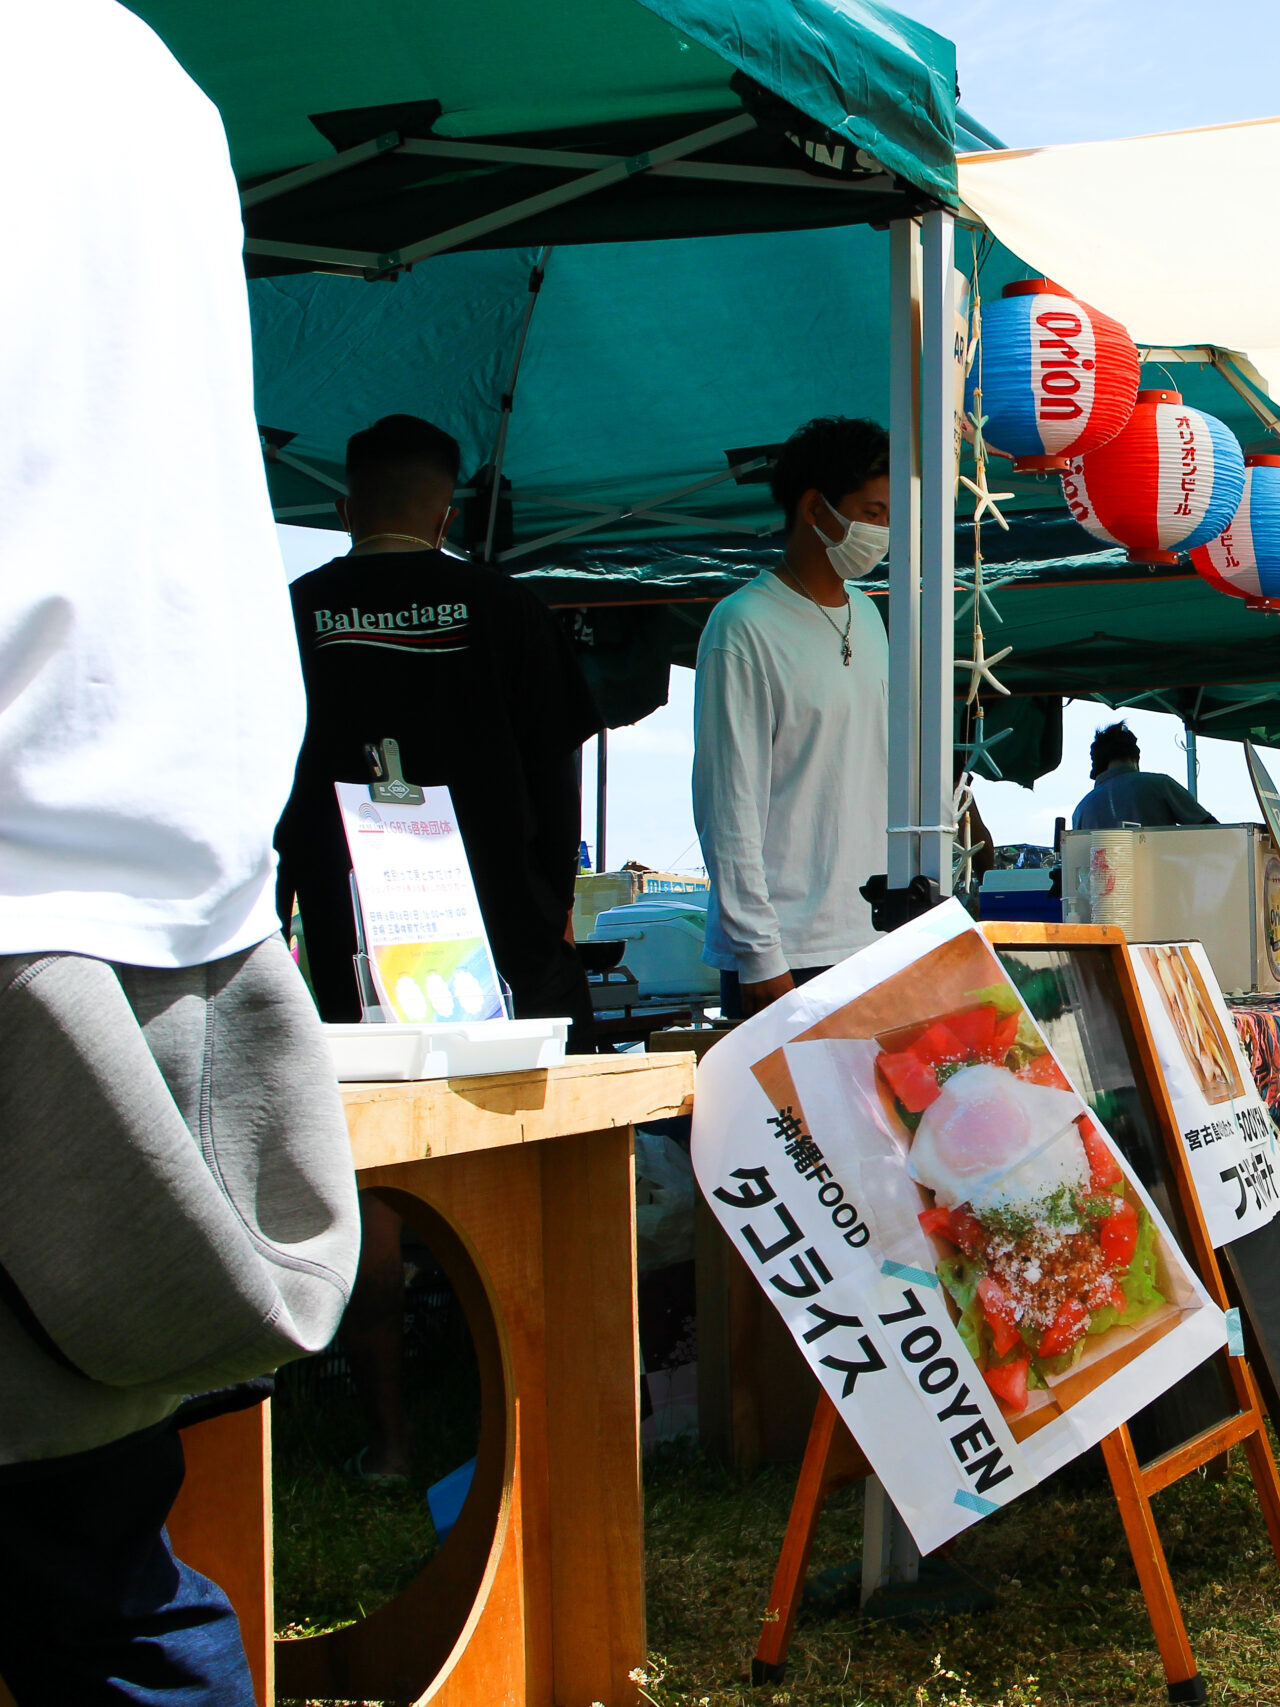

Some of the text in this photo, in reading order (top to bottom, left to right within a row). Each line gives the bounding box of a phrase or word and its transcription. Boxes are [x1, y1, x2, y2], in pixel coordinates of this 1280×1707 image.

[1035, 311, 1096, 420] Orion
[1173, 415, 1198, 516] オリオンビール
[313, 603, 469, 633] Balenciaga
[766, 1106, 872, 1250] 沖縄FOOD
[712, 1164, 888, 1399] タコライス
[877, 1287, 1015, 1495] 700YEN
